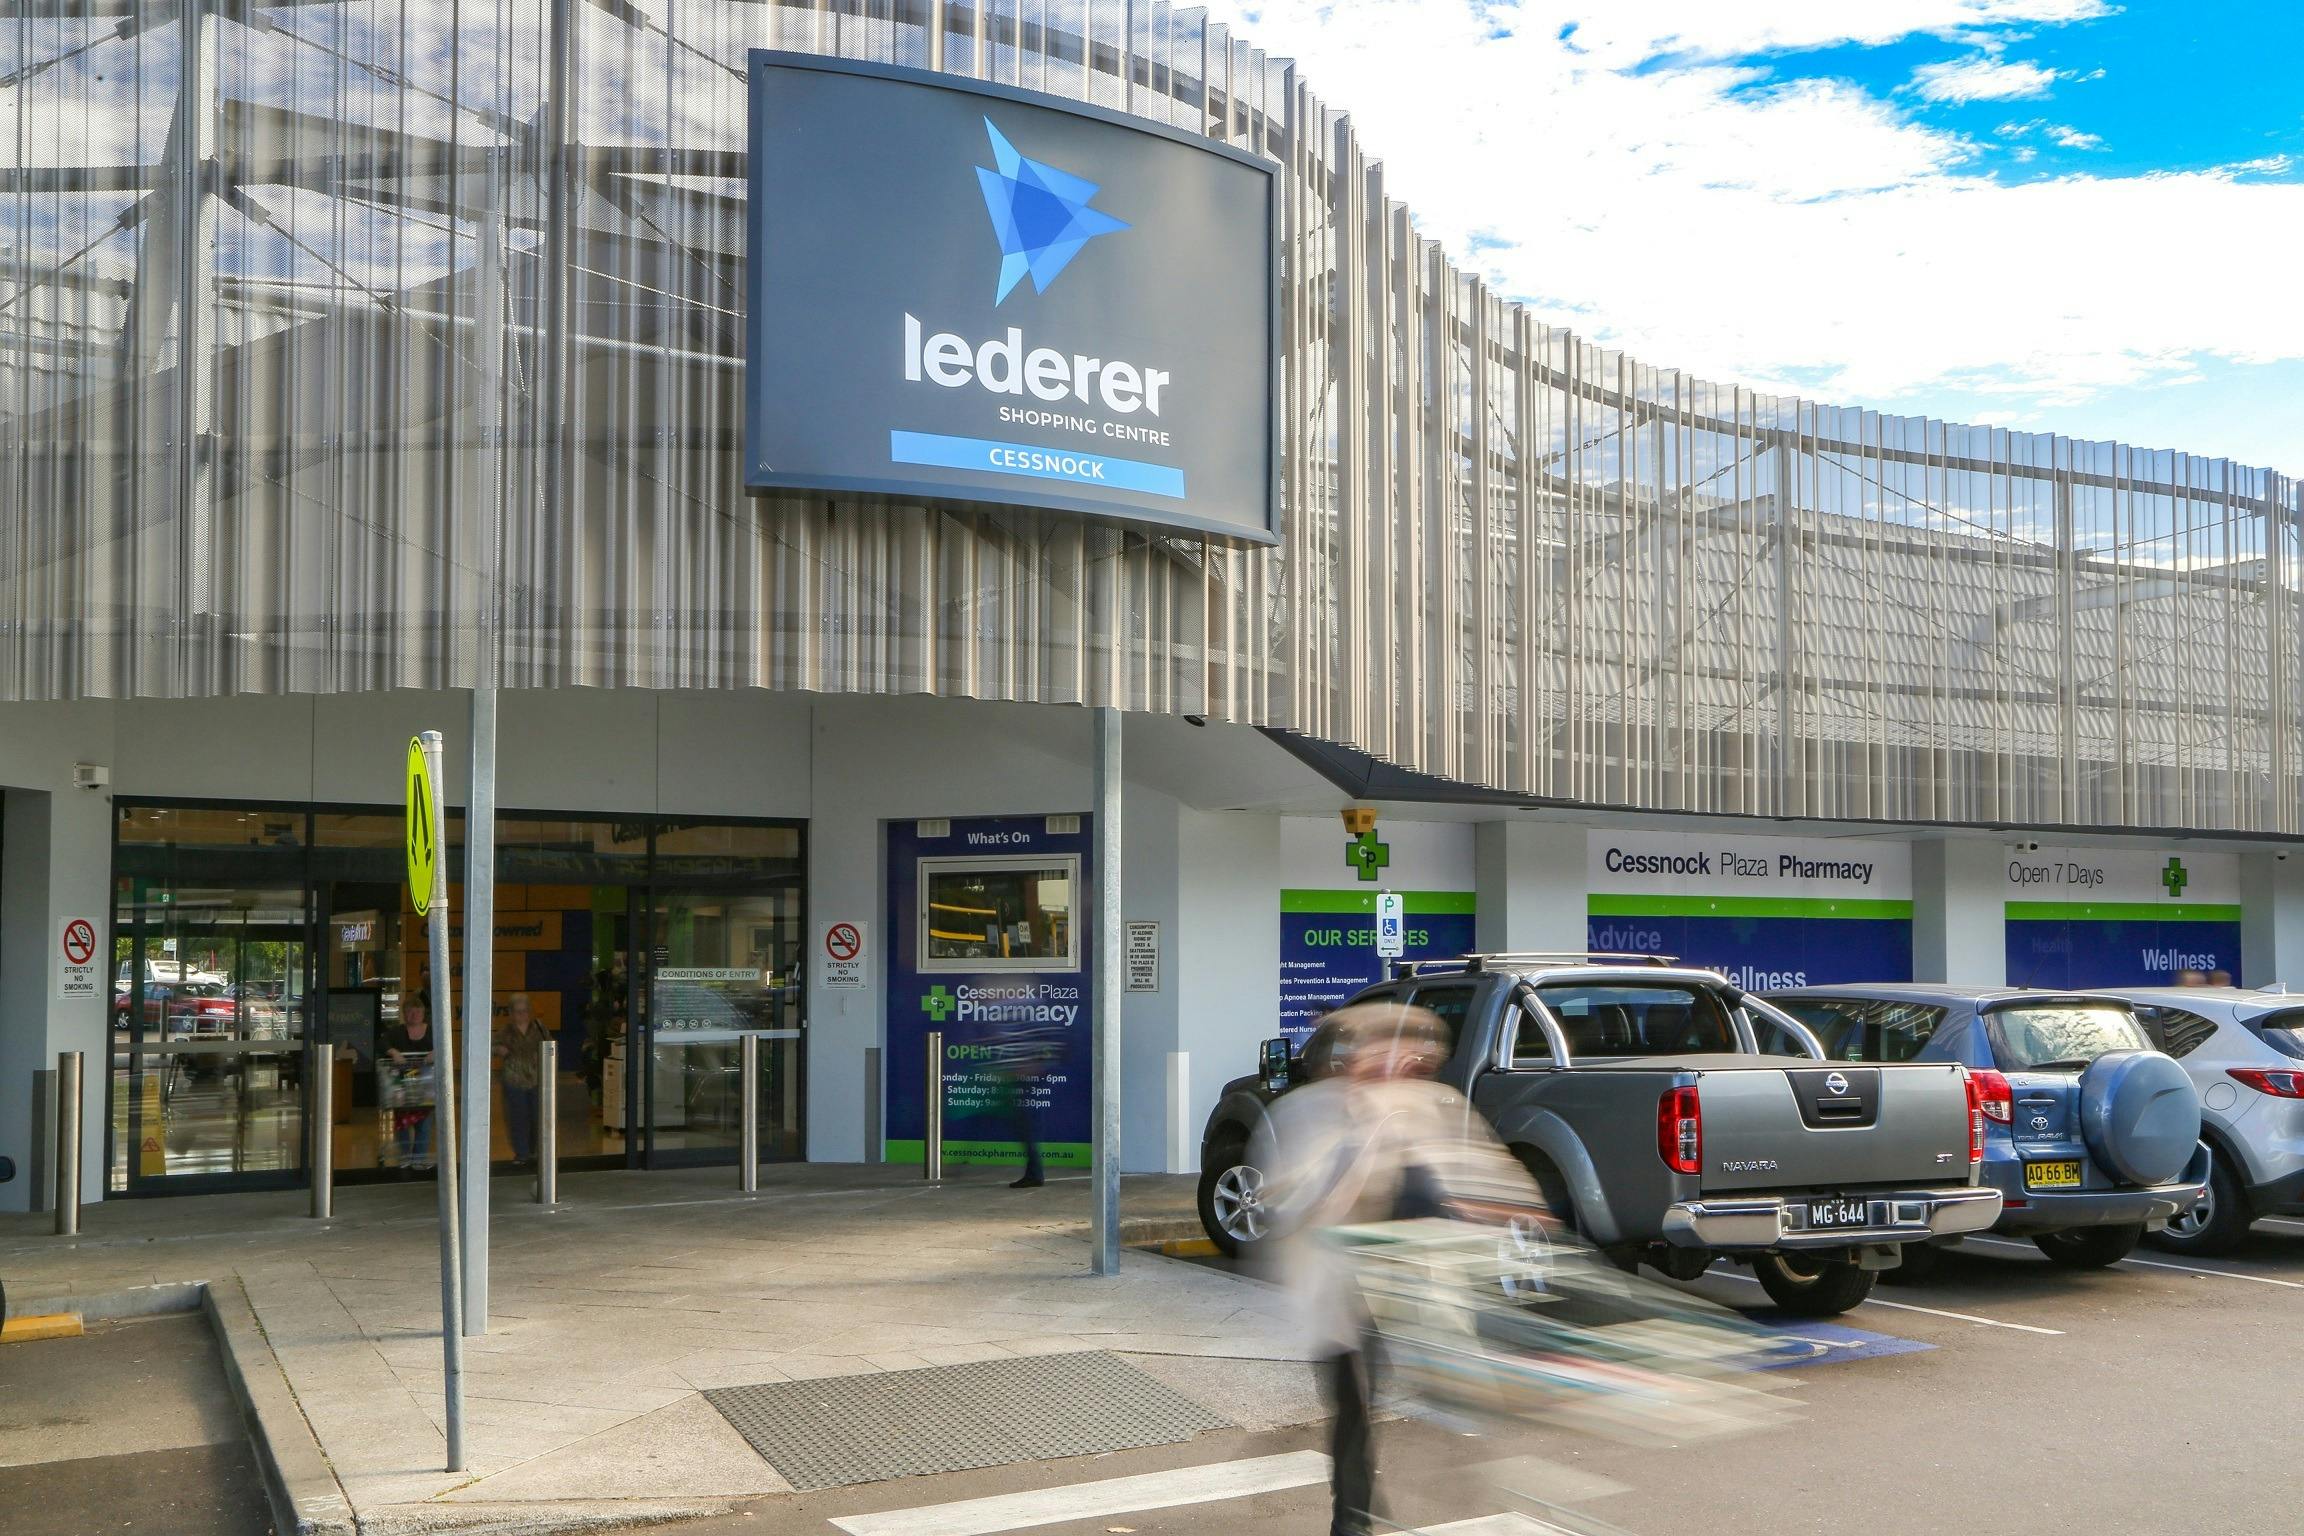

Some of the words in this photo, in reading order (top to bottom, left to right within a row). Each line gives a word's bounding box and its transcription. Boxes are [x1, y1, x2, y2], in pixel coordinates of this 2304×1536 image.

[905, 311, 1170, 417] lederer
[999, 406, 1097, 435] SHOPPING
[1103, 422, 1170, 447] CENTRE
[989, 448, 1105, 479] CESSNOCK
[968, 832, 1009, 845] What's
[1012, 831, 1030, 843] On
[1605, 848, 1711, 875] Cessnock
[1720, 852, 1768, 876] Plaza
[1779, 855, 1873, 884] Pharmacy
[2009, 861, 2050, 886] Open
[2054, 863, 2063, 882] 7
[2068, 863, 2104, 888] Days
[1304, 930, 1342, 946] OUR
[1347, 929, 1429, 946] SERES
[1587, 925, 1662, 950] Advice
[1288, 961, 1326, 970] Management
[2142, 949, 2216, 971] Wellness
[64, 966, 94, 974] STRICTLY
[661, 970, 714, 978] CONDITIONS
[715, 970, 727, 978] OF
[729, 970, 756, 978] ENTRY
[64, 983, 93, 991] SMOKING
[1293, 977, 1325, 985] Prevention
[1331, 976, 1368, 985] Management
[956, 984, 1036, 1000] Cessnock
[1039, 984, 1079, 999] Plaza
[1307, 993, 1345, 1002] Management
[957, 1000, 1079, 1026] Pharmacy
[947, 1045, 991, 1059] OPEN
[942, 1073, 968, 1084] onday
[1046, 1074, 1067, 1084] 6pm
[947, 1085, 990, 1096] Saturday:
[1031, 1086, 1051, 1096] 3pm
[948, 1097, 984, 1108] Sunday:
[1936, 1153, 1953, 1163] ST
[1723, 1160, 1778, 1171] NAVARA
